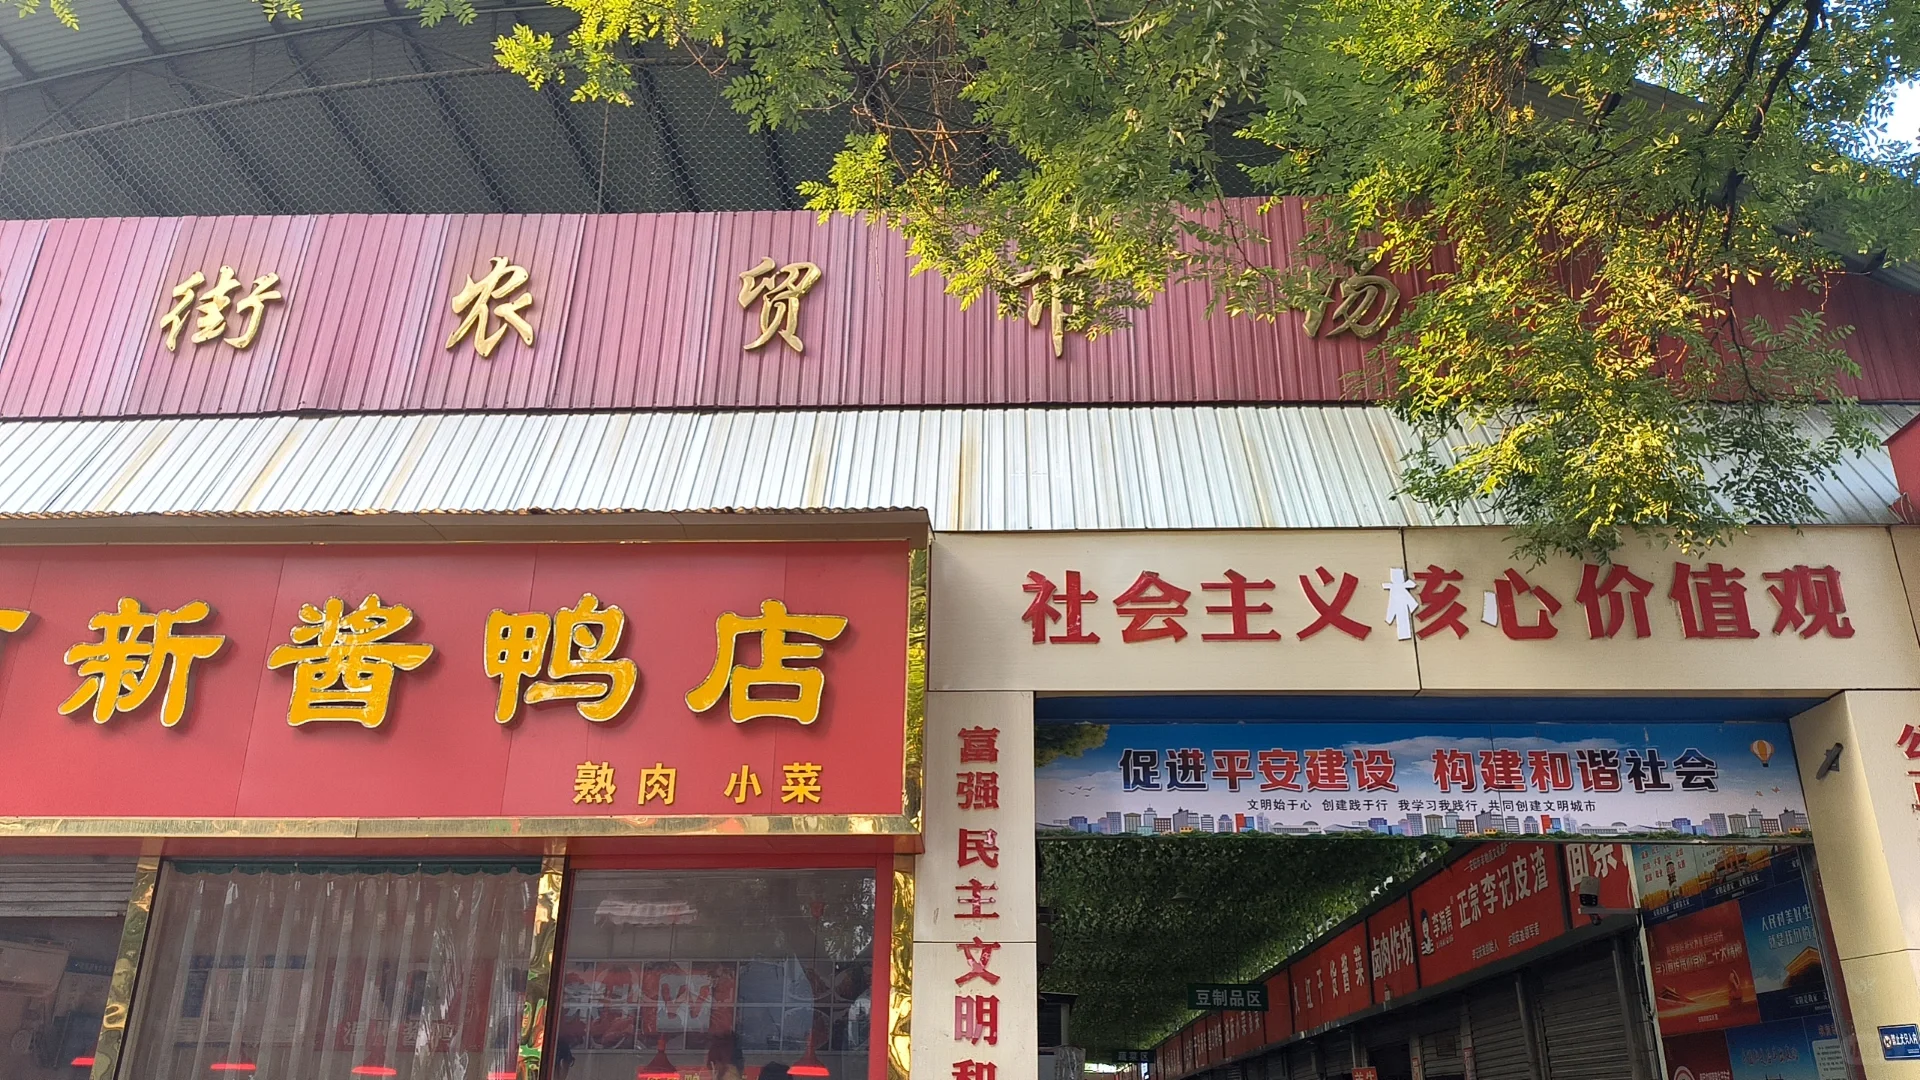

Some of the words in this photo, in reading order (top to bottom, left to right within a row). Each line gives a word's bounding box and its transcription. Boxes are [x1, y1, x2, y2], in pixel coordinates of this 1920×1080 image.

[1022, 564, 1855, 645] 社会主义核心价值观
[0, 592, 849, 729] 新酱鸭店
[574, 761, 677, 805] 熟肉
[724, 761, 823, 804] 小菜
[1118, 747, 1398, 792] 促进平安建设
[1431, 746, 1718, 793] 构建和谐社会
[1247, 799, 1312, 812] 文明始于心
[1322, 799, 1388, 812] 创建践于行
[1457, 846, 1548, 928] 正宗李记皮渣
[1371, 919, 1414, 981] 卤肉作坊
[1768, 925, 1817, 950] 就是我们的
[1195, 989, 1262, 1007] 豆制品区
